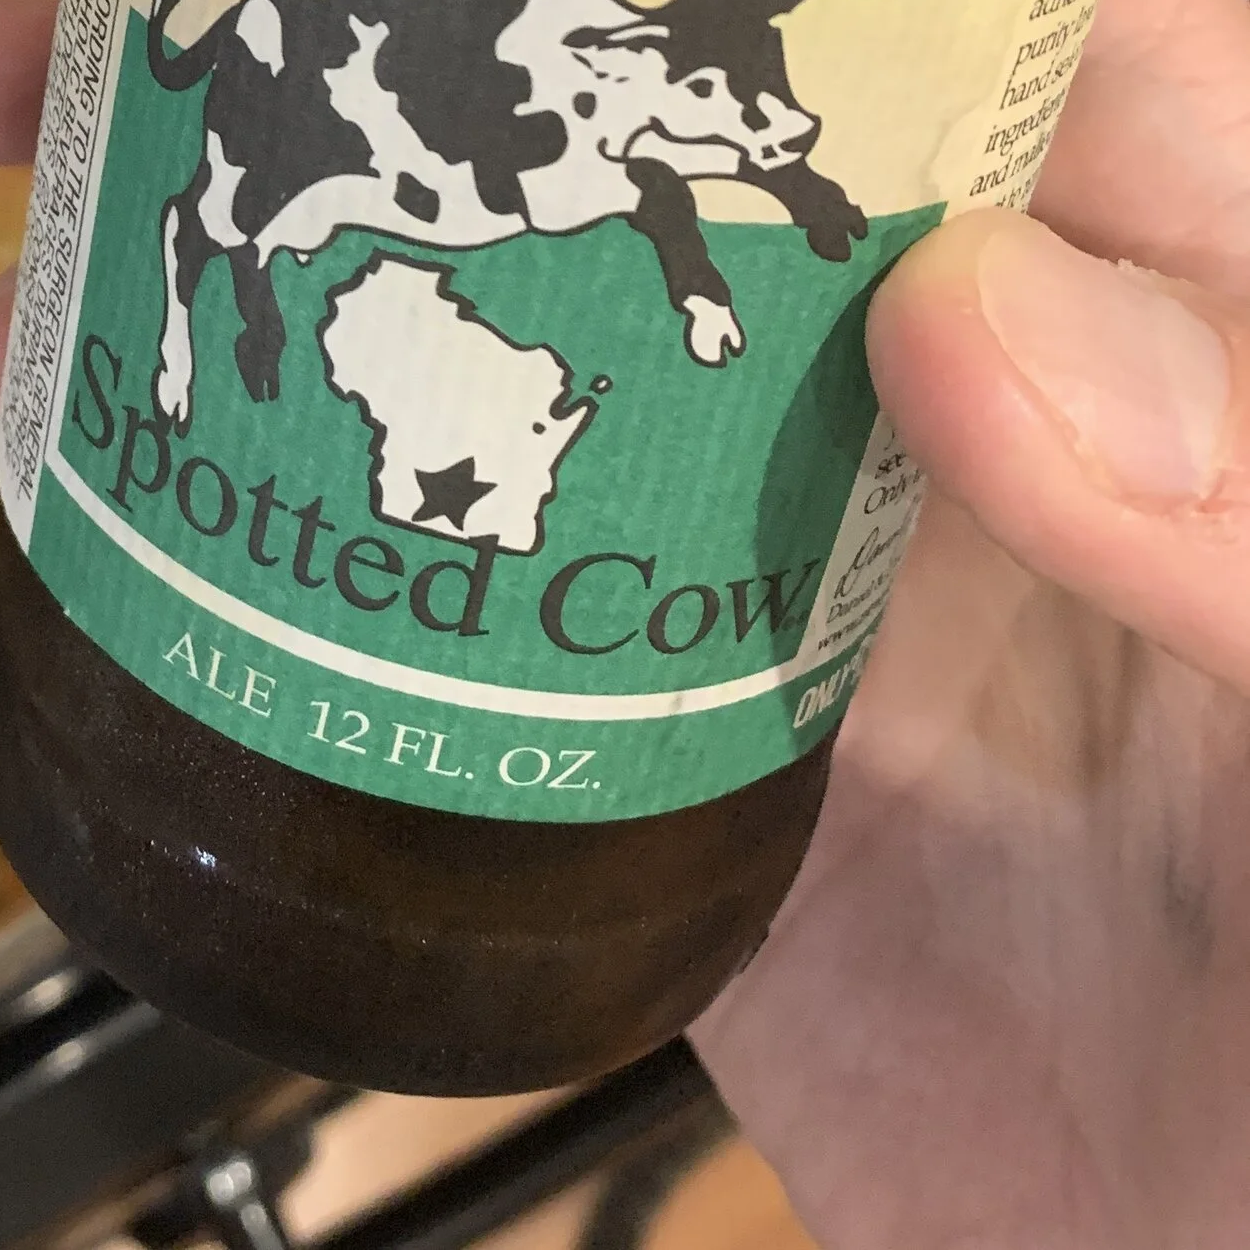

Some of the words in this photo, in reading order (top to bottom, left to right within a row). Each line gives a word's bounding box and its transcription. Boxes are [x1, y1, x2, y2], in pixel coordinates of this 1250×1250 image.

[1013, 21, 1075, 75] purity
[1000, 60, 1056, 110] hand
[73, 119, 91, 163] TO
[61, 167, 83, 232] THE
[970, 154, 1012, 196] and
[39, 227, 72, 377] SURGEON
[16, 373, 49, 501] GENERAL
[73, 334, 498, 637] Spotted
[540, 552, 821, 656] Cow
[163, 631, 278, 718] ALE
[306, 699, 367, 754] 12
[382, 722, 476, 781] FL.
[498, 746, 602, 790] OZ.
